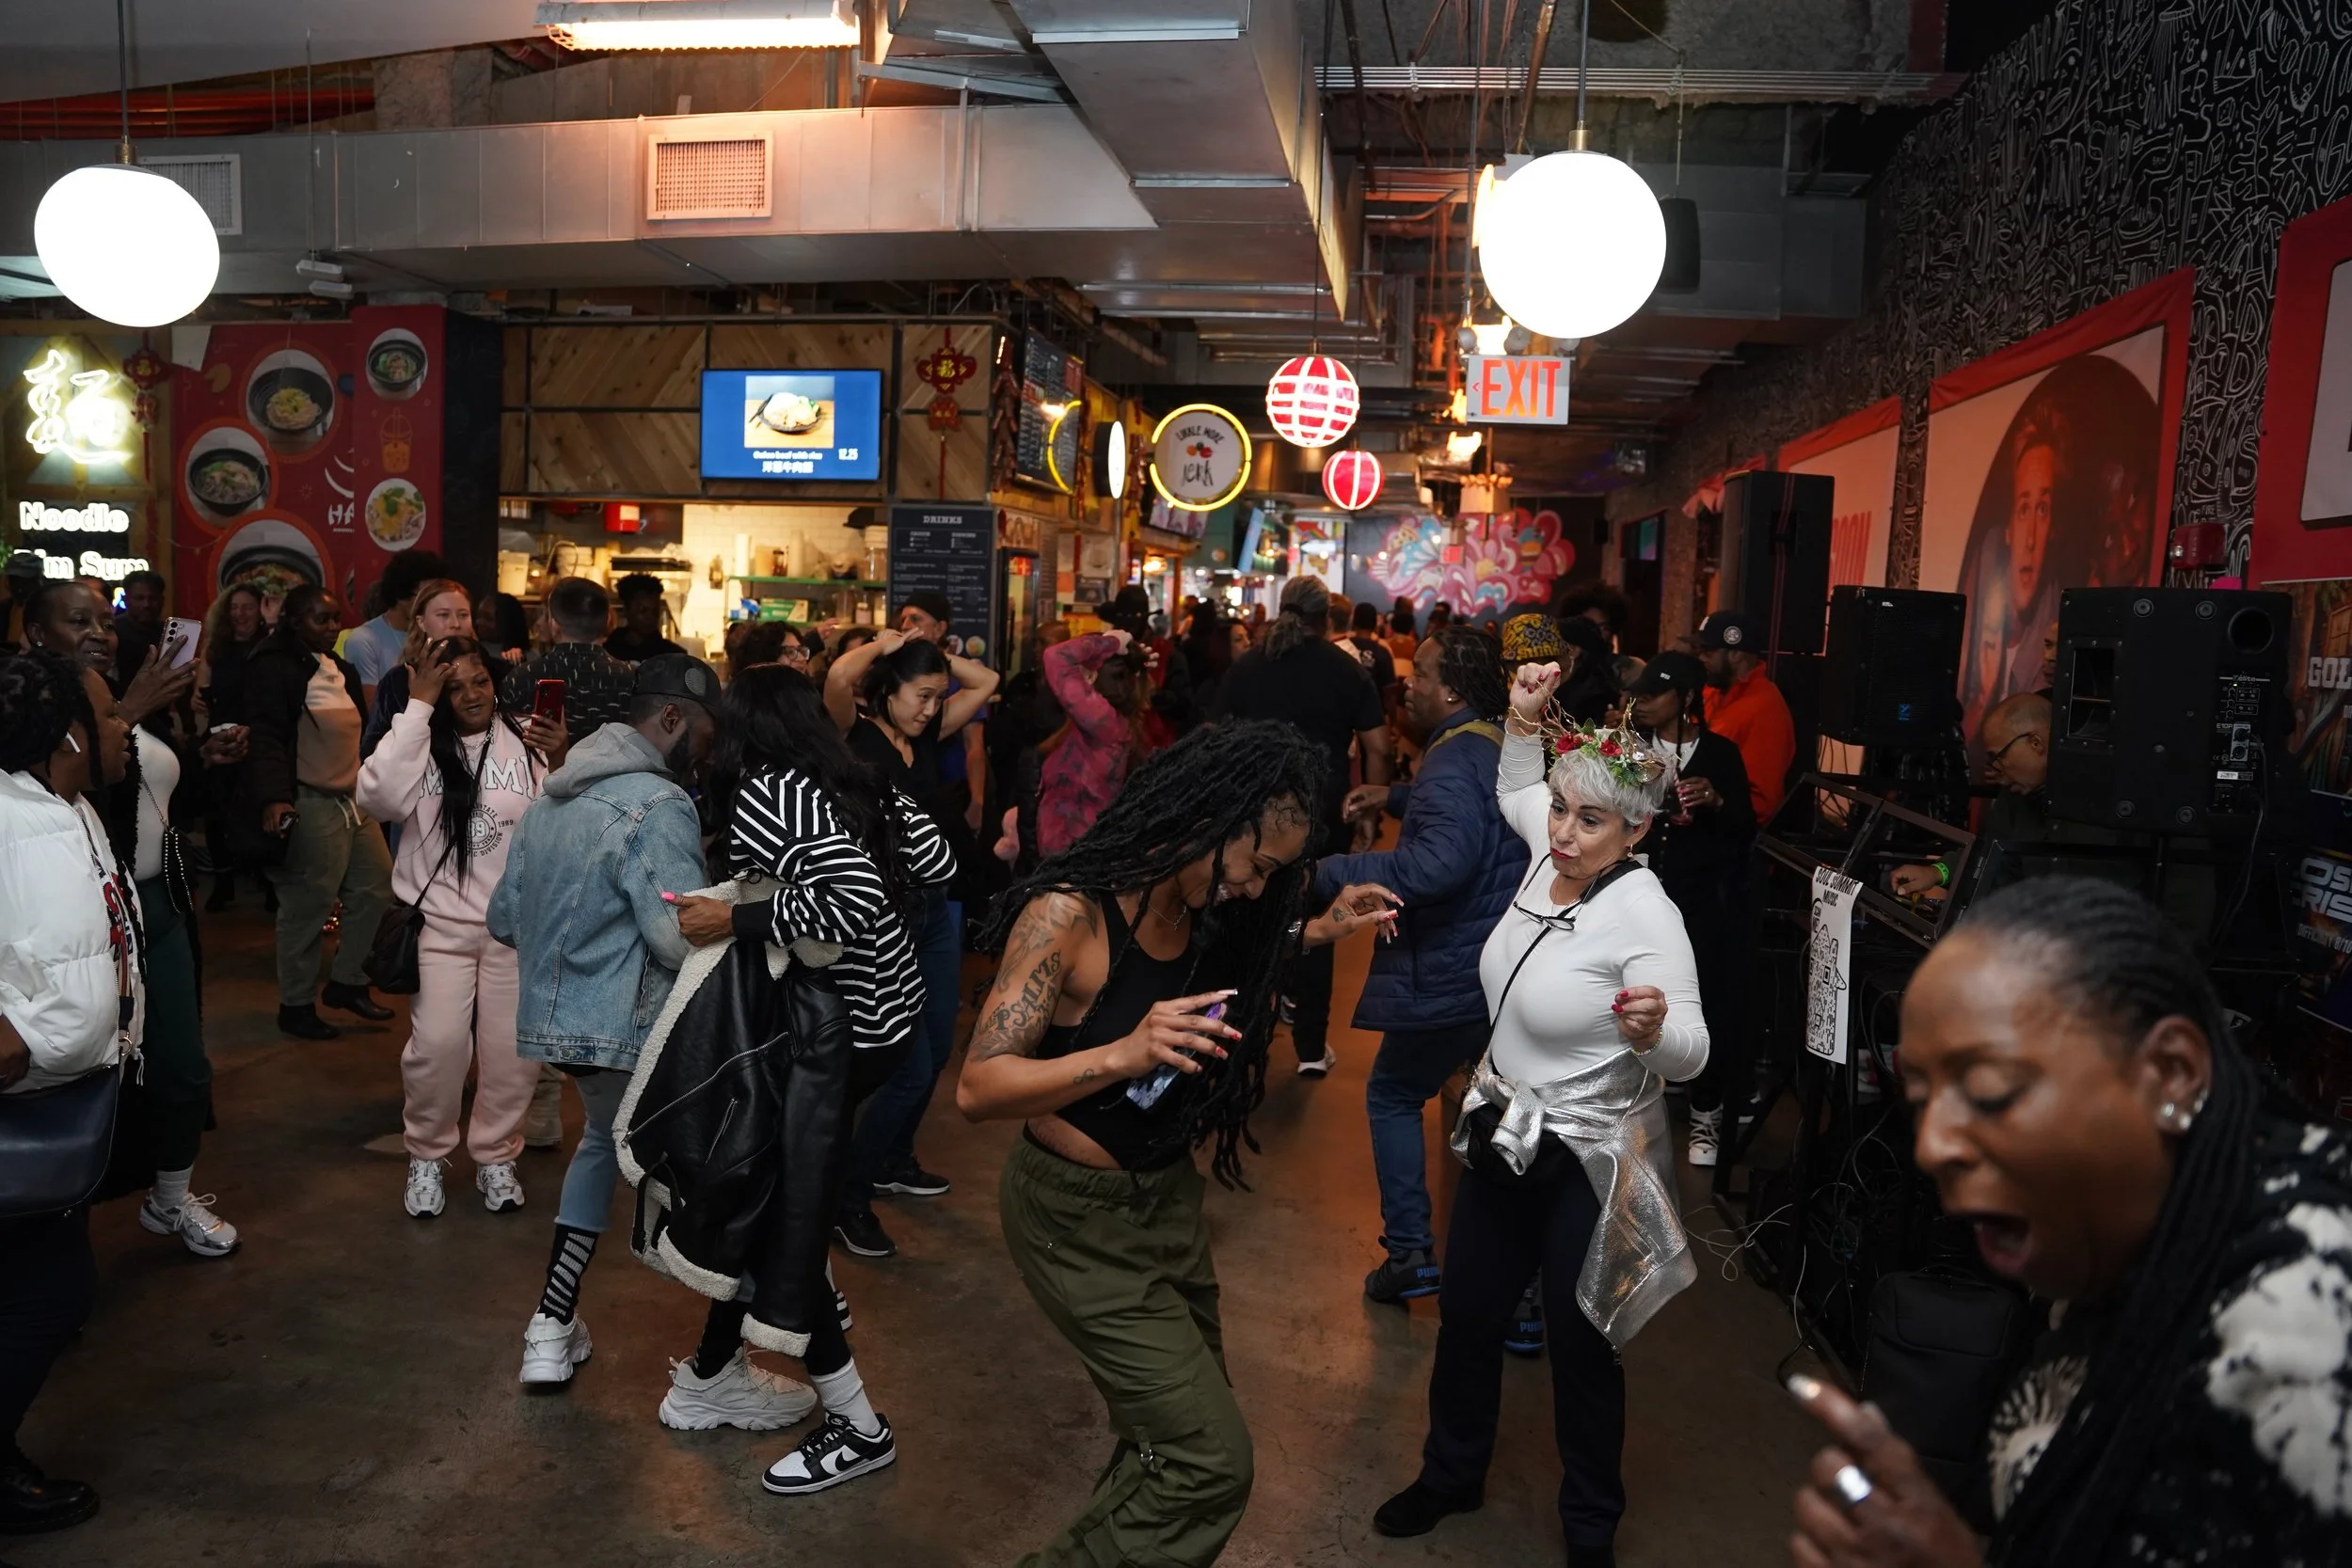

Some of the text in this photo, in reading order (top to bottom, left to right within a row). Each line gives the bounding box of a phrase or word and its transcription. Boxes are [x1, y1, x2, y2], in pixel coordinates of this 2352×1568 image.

[1481, 359, 1563, 418] EXIT
[20, 501, 129, 532] Noodle
[923, 515, 962, 524] DRINKS
[80, 551, 150, 580] Sum
[418, 756, 540, 800] MMI
[1816, 867, 1858, 895] SOUL SUMMIT
[1823, 889, 1838, 907] MUSIC
